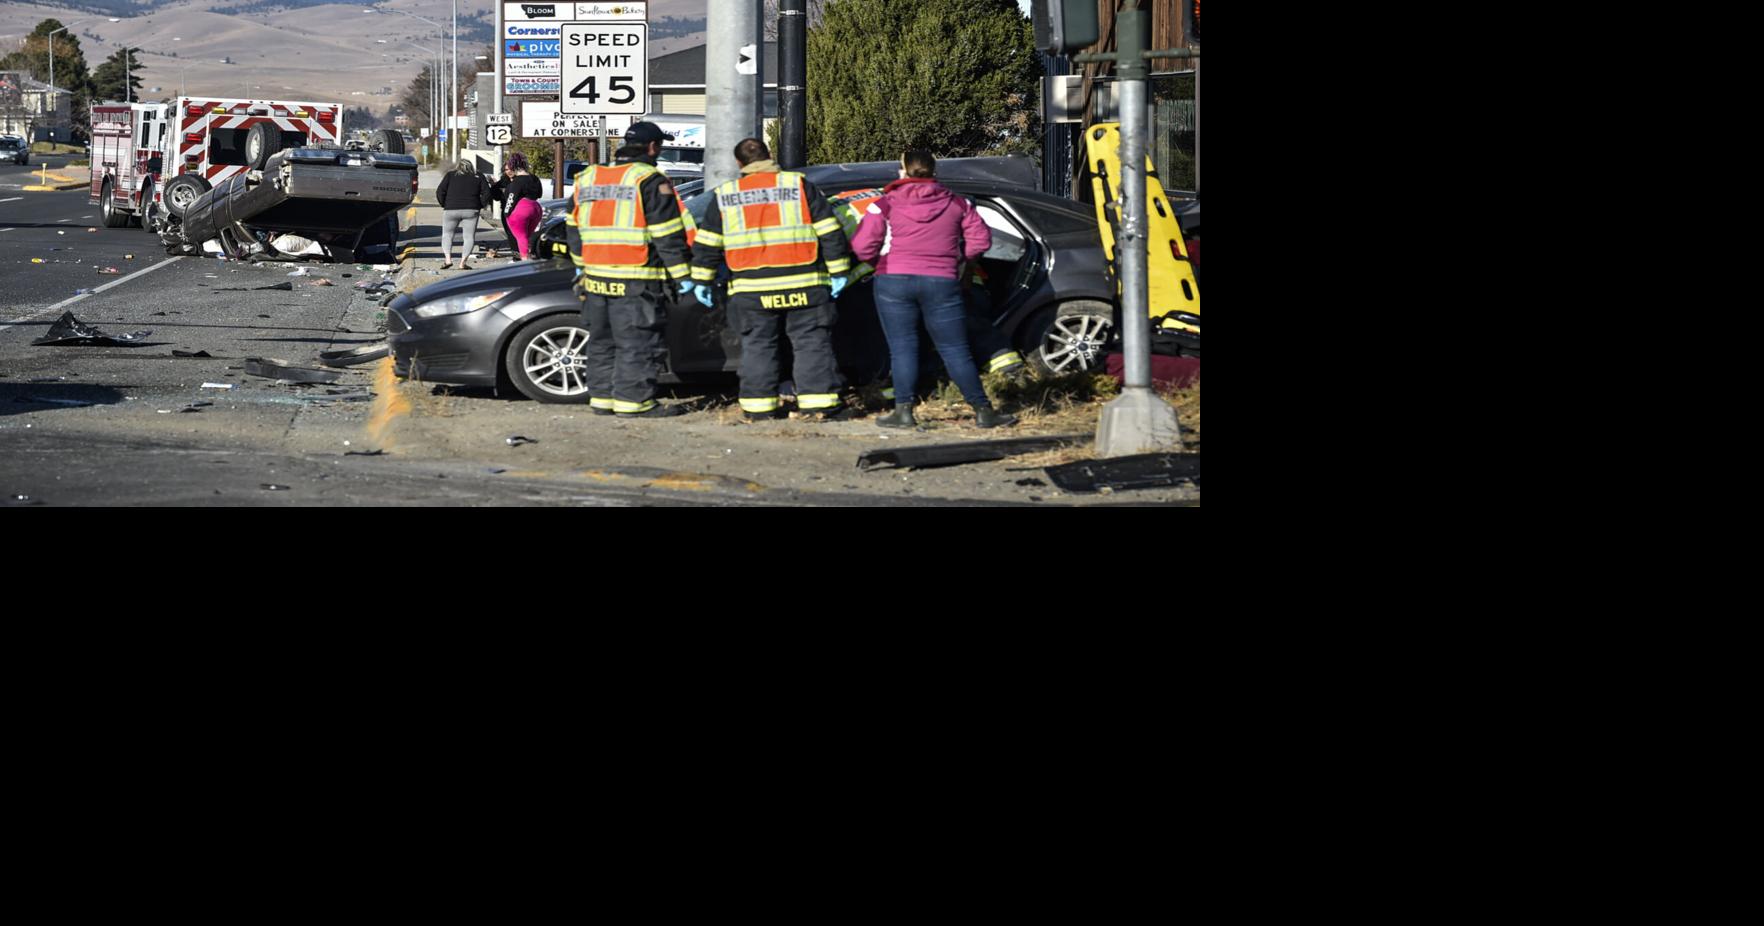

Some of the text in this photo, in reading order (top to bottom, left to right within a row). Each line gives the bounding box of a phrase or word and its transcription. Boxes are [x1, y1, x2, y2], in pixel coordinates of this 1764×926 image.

[569, 33, 640, 46] SPEED
[529, 42, 560, 54] pivo
[576, 55, 631, 68] LIMIT
[569, 76, 636, 104] 45
[491, 128, 508, 140] 12
[533, 128, 620, 136] AT CORNERSTNE
[662, 129, 681, 137] ted
[721, 187, 800, 207] HELENA FIRE
[584, 278, 626, 296] OEHLER
[760, 292, 809, 309] WELCH
